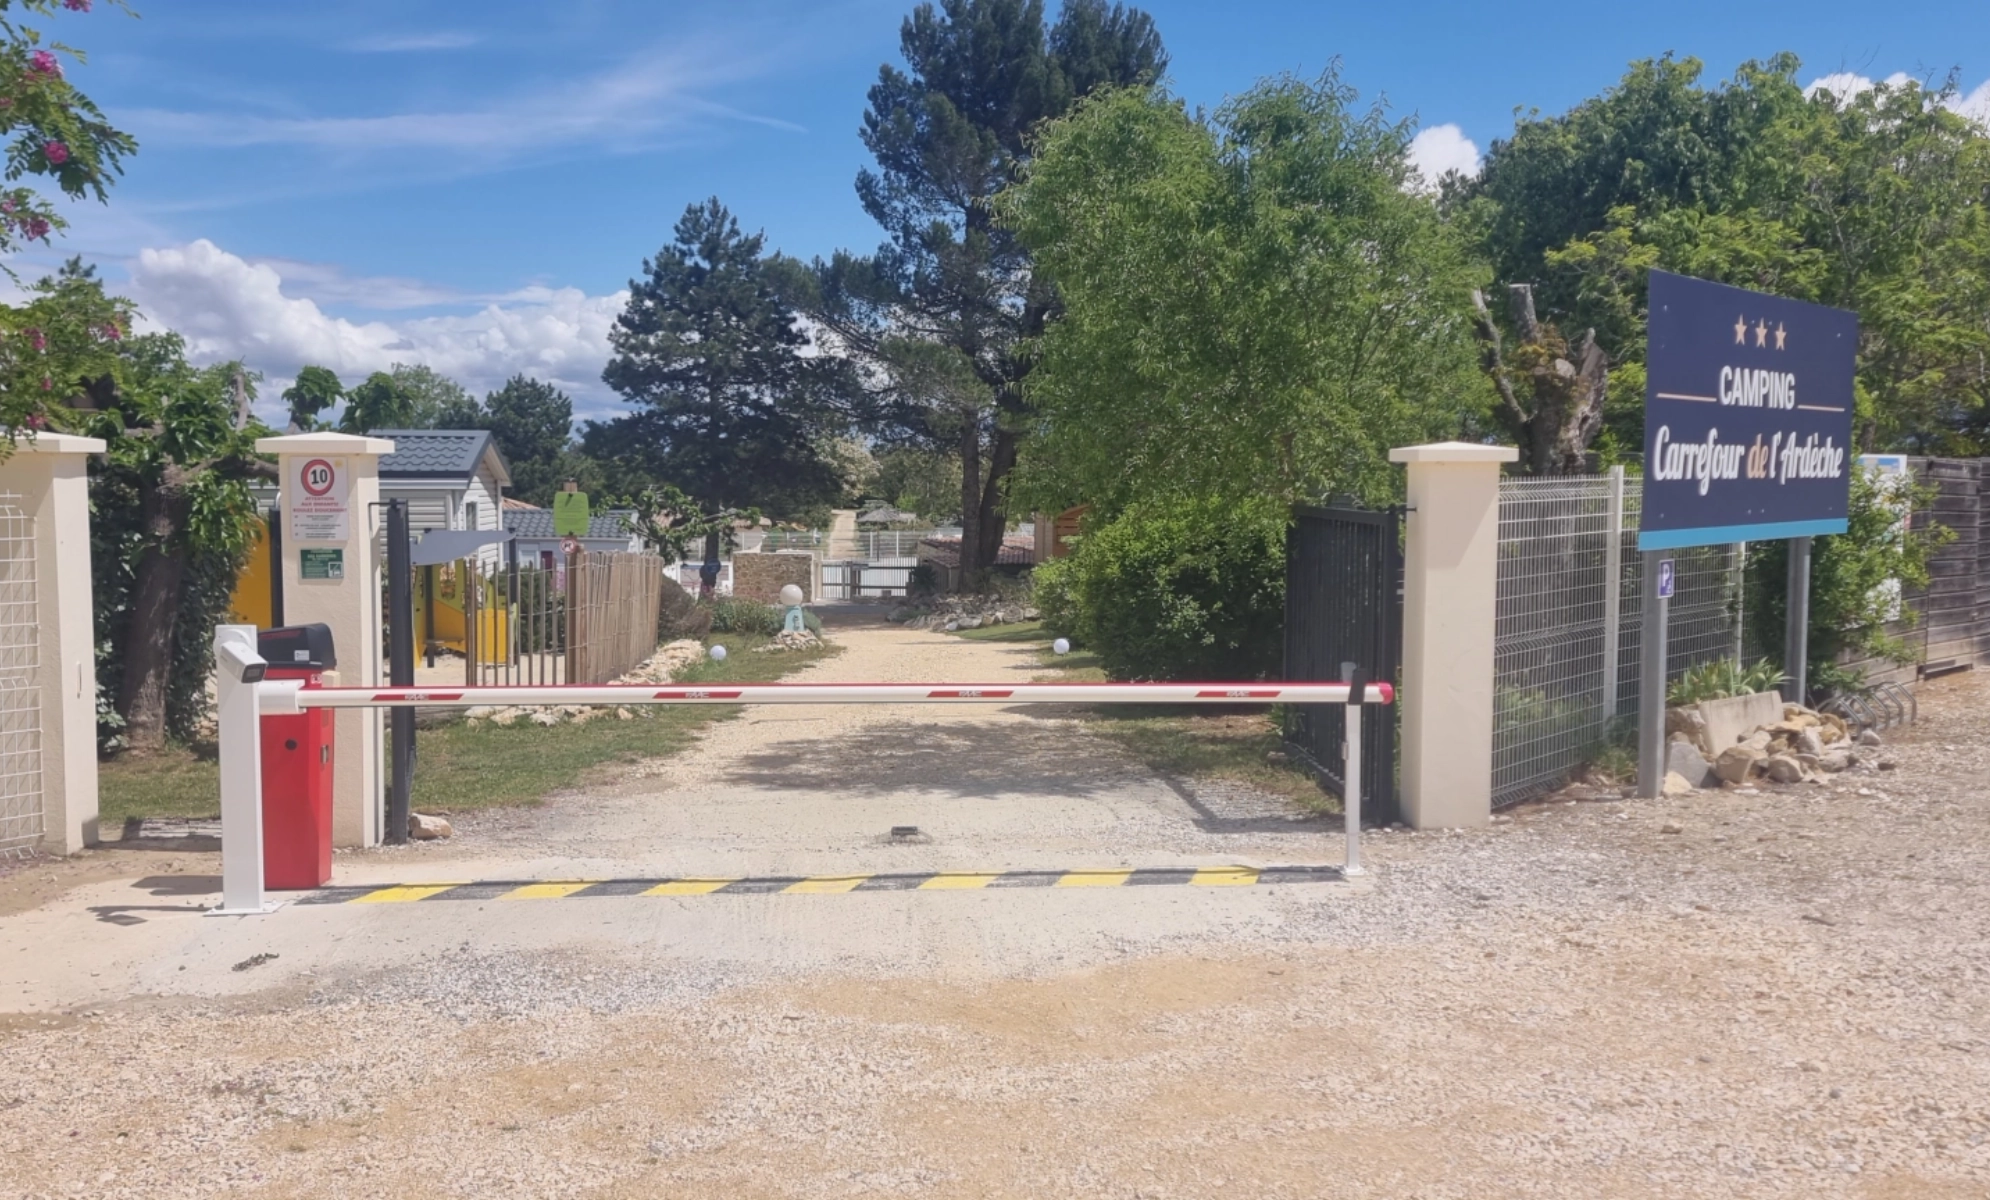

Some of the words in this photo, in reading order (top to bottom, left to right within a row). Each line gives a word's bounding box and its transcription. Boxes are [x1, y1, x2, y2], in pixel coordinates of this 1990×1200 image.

[1720, 365, 1795, 410] CAMPING
[310, 468, 328, 485] 10
[1653, 425, 1745, 496] Carrefour
[1747, 433, 1768, 479] de
[1662, 563, 1670, 587] P
